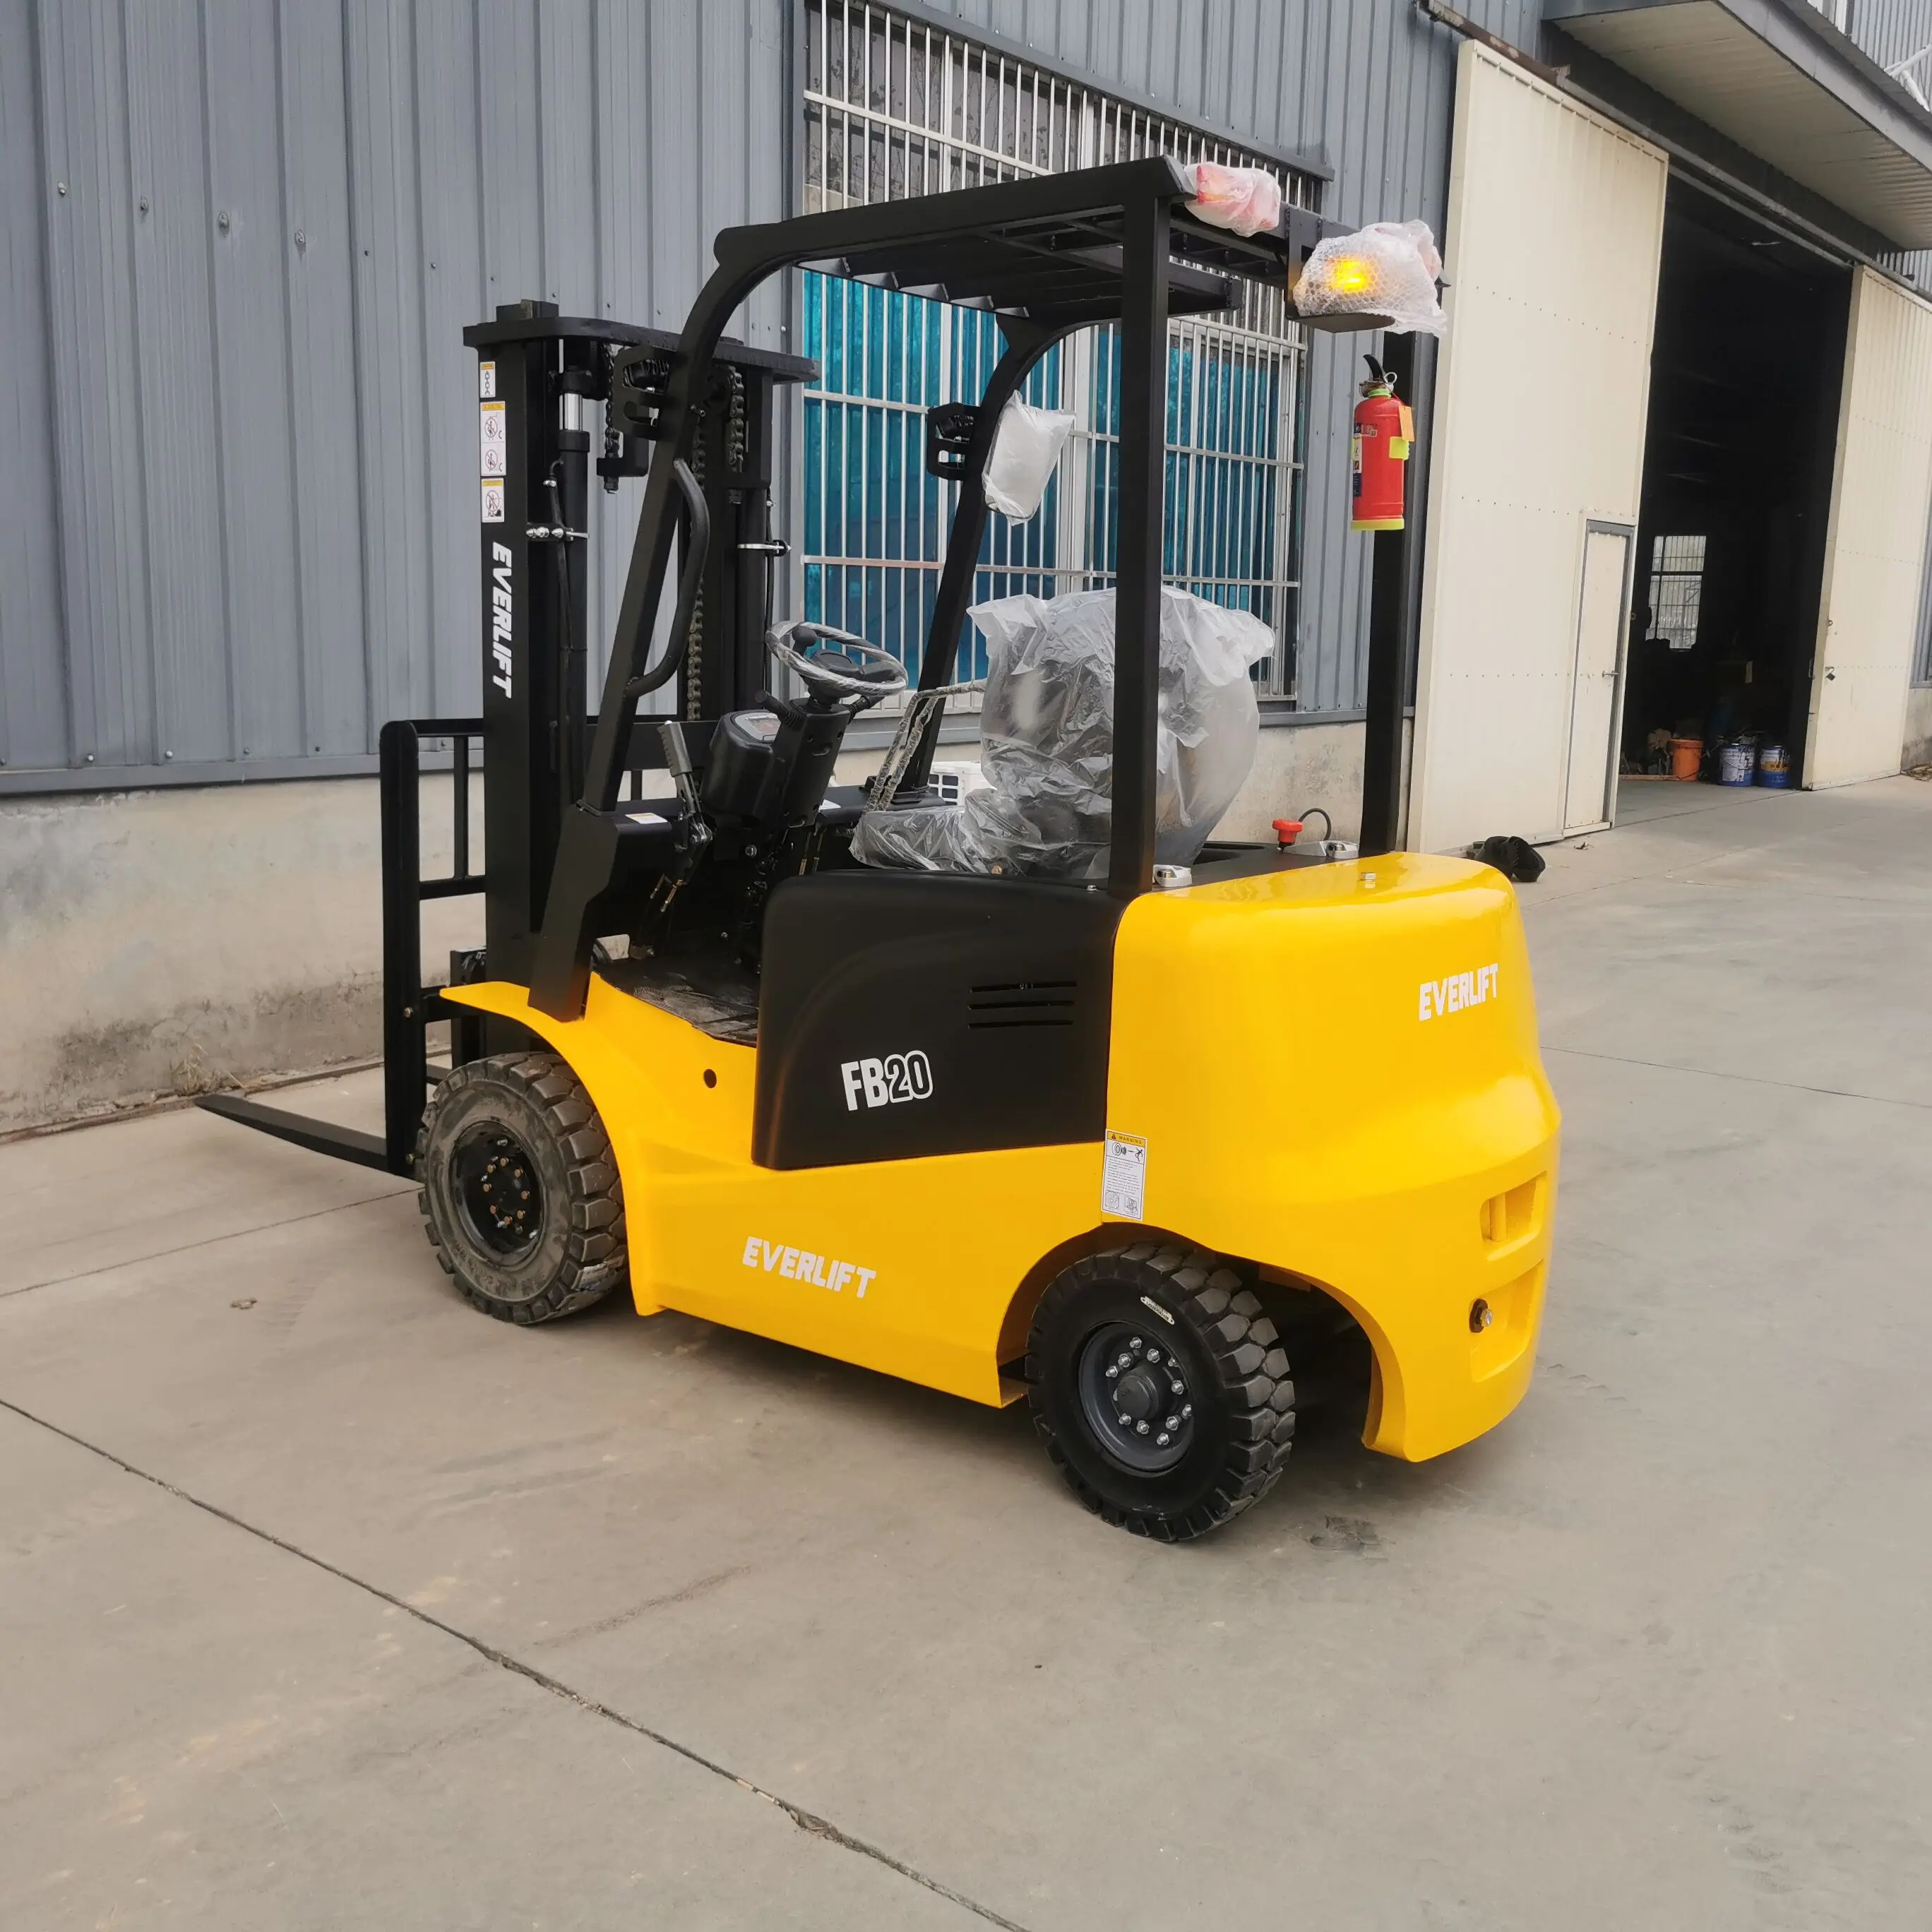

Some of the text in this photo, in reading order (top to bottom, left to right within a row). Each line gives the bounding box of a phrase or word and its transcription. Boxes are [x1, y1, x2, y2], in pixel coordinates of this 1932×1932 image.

[493, 542, 512, 698] EVERLIFT
[1419, 962, 1498, 1022] EVERLIFT
[841, 1050, 934, 1111] FB20
[1119, 1135, 1142, 1145] WARNING
[742, 1236, 876, 1299] EVERLIFT
